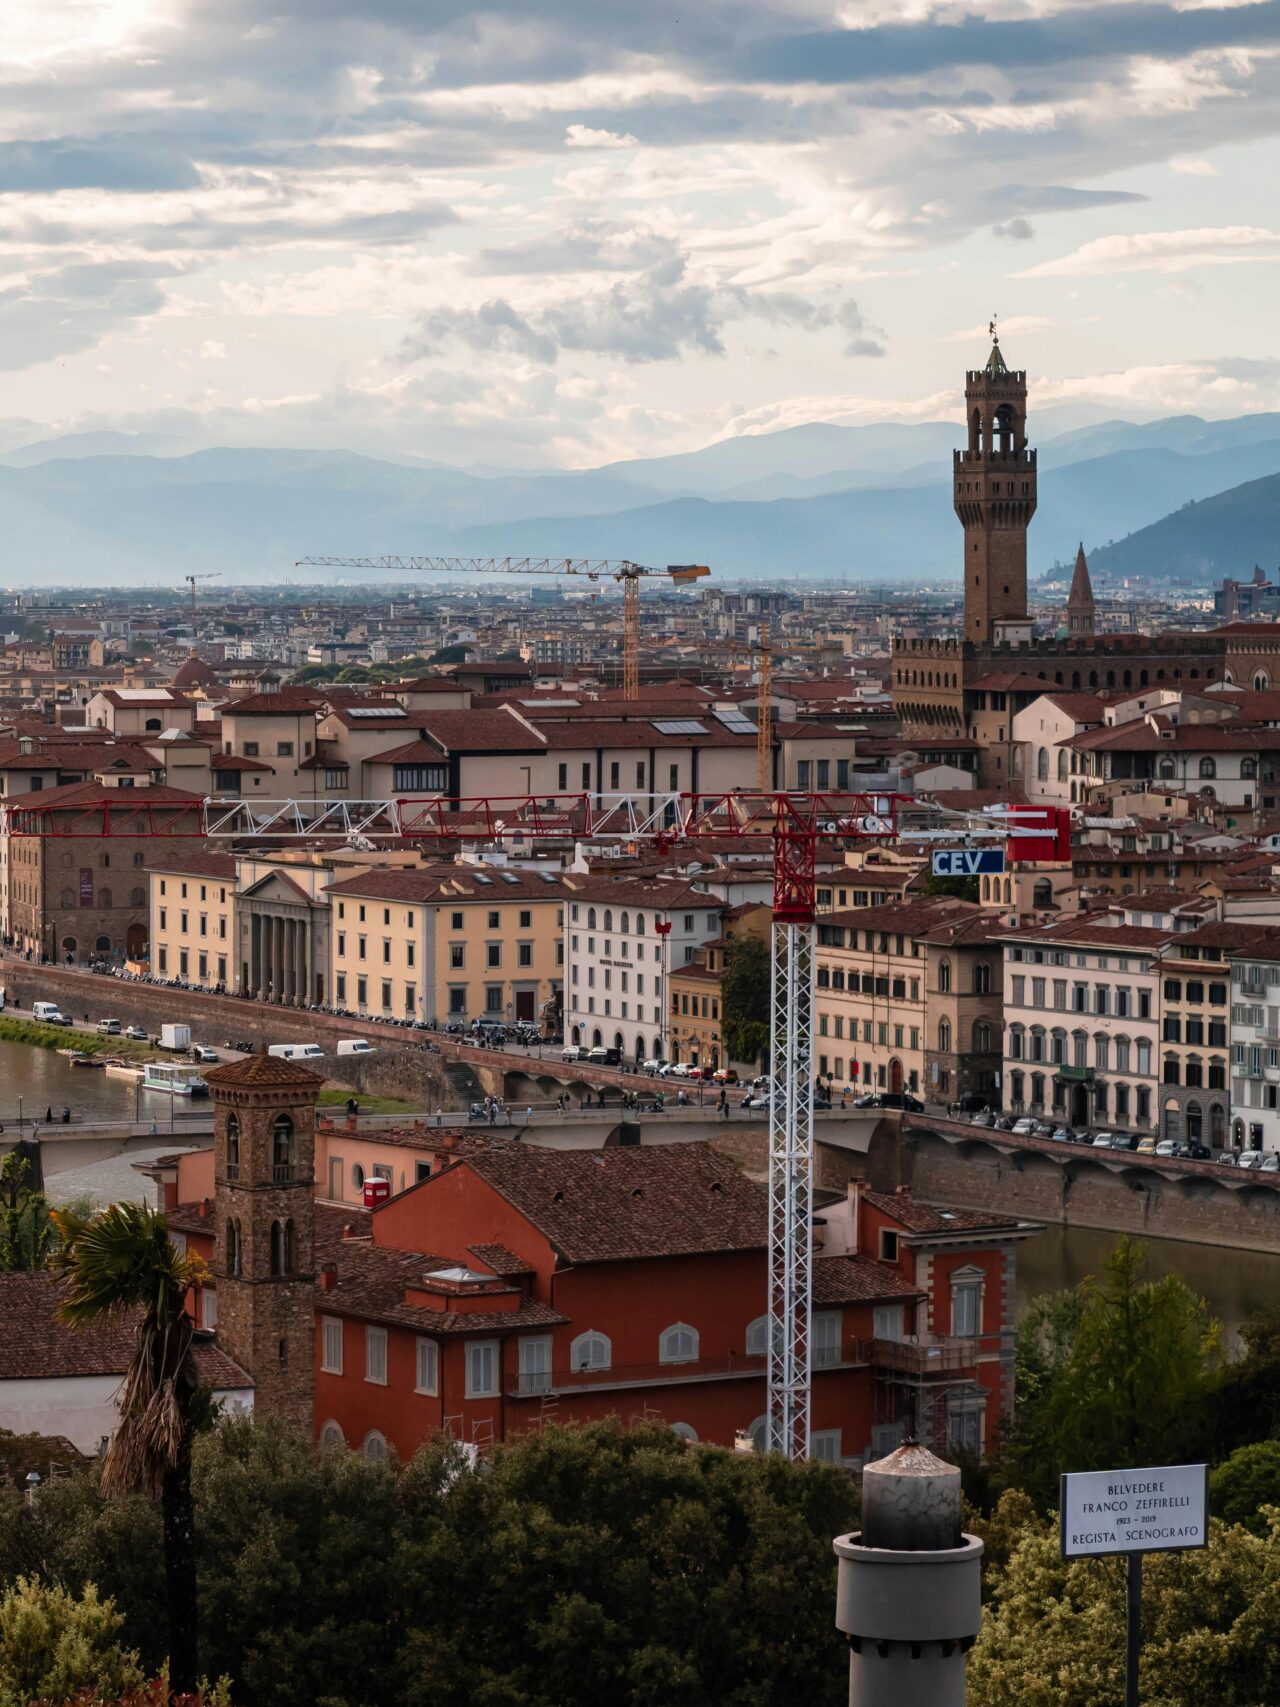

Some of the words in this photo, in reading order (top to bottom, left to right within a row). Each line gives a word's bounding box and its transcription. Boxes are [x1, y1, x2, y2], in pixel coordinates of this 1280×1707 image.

[934, 852, 983, 873] CEV
[1108, 1482, 1165, 1495] BELVEDERE
[1083, 1501, 1128, 1513] FRANCO
[1135, 1497, 1190, 1510] ZEFFIRELLI
[1117, 1517, 1131, 1525] 1923
[1072, 1533, 1116, 1545] REGISTA
[1125, 1526, 1199, 1541] SCENOGRAFO
